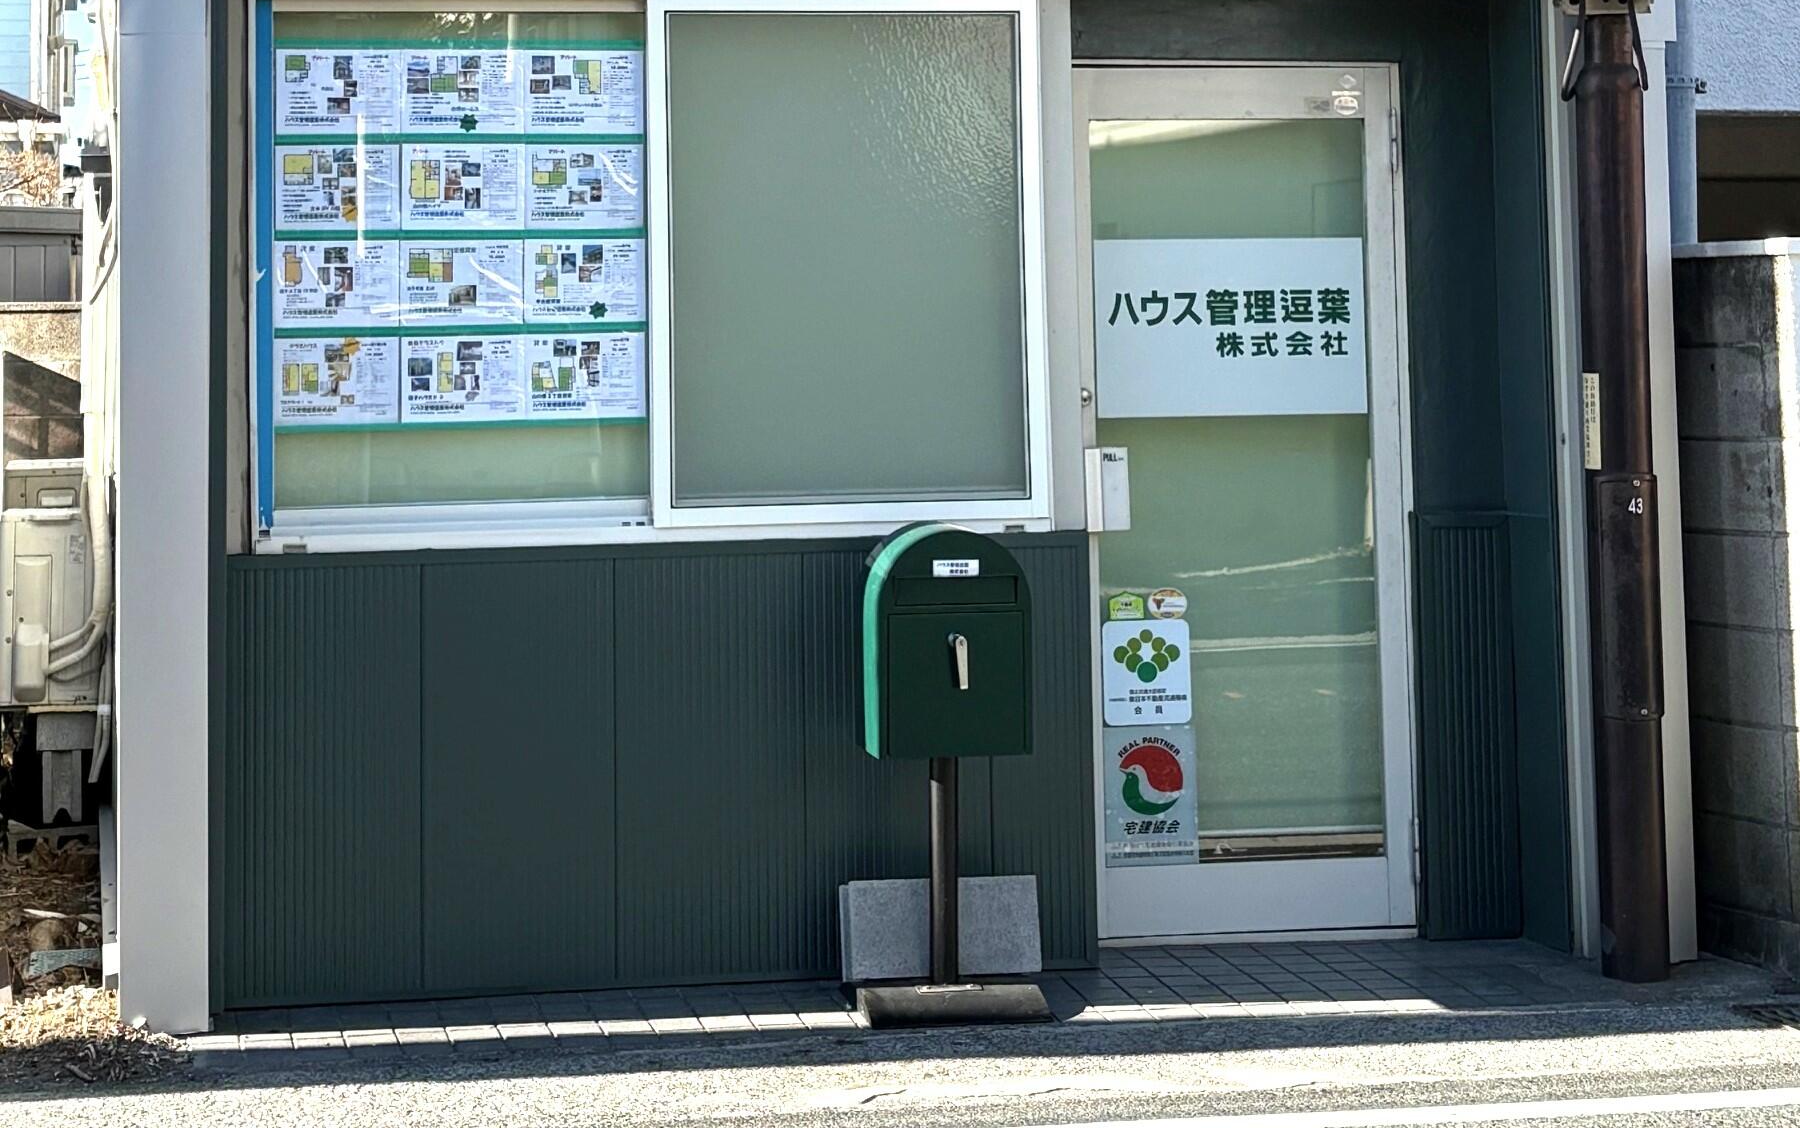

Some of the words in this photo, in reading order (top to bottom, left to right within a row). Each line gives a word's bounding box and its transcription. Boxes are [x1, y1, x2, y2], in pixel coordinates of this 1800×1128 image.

[1215, 330, 1349, 358] 株式会社
[1103, 452, 1118, 462] PULL
[1628, 497, 1643, 514] 43
[1134, 705, 1163, 715] 会員
[1117, 739, 1140, 759] REAL
[1141, 736, 1181, 757] PARTNER
[1123, 819, 1181, 835] 宅建協会
